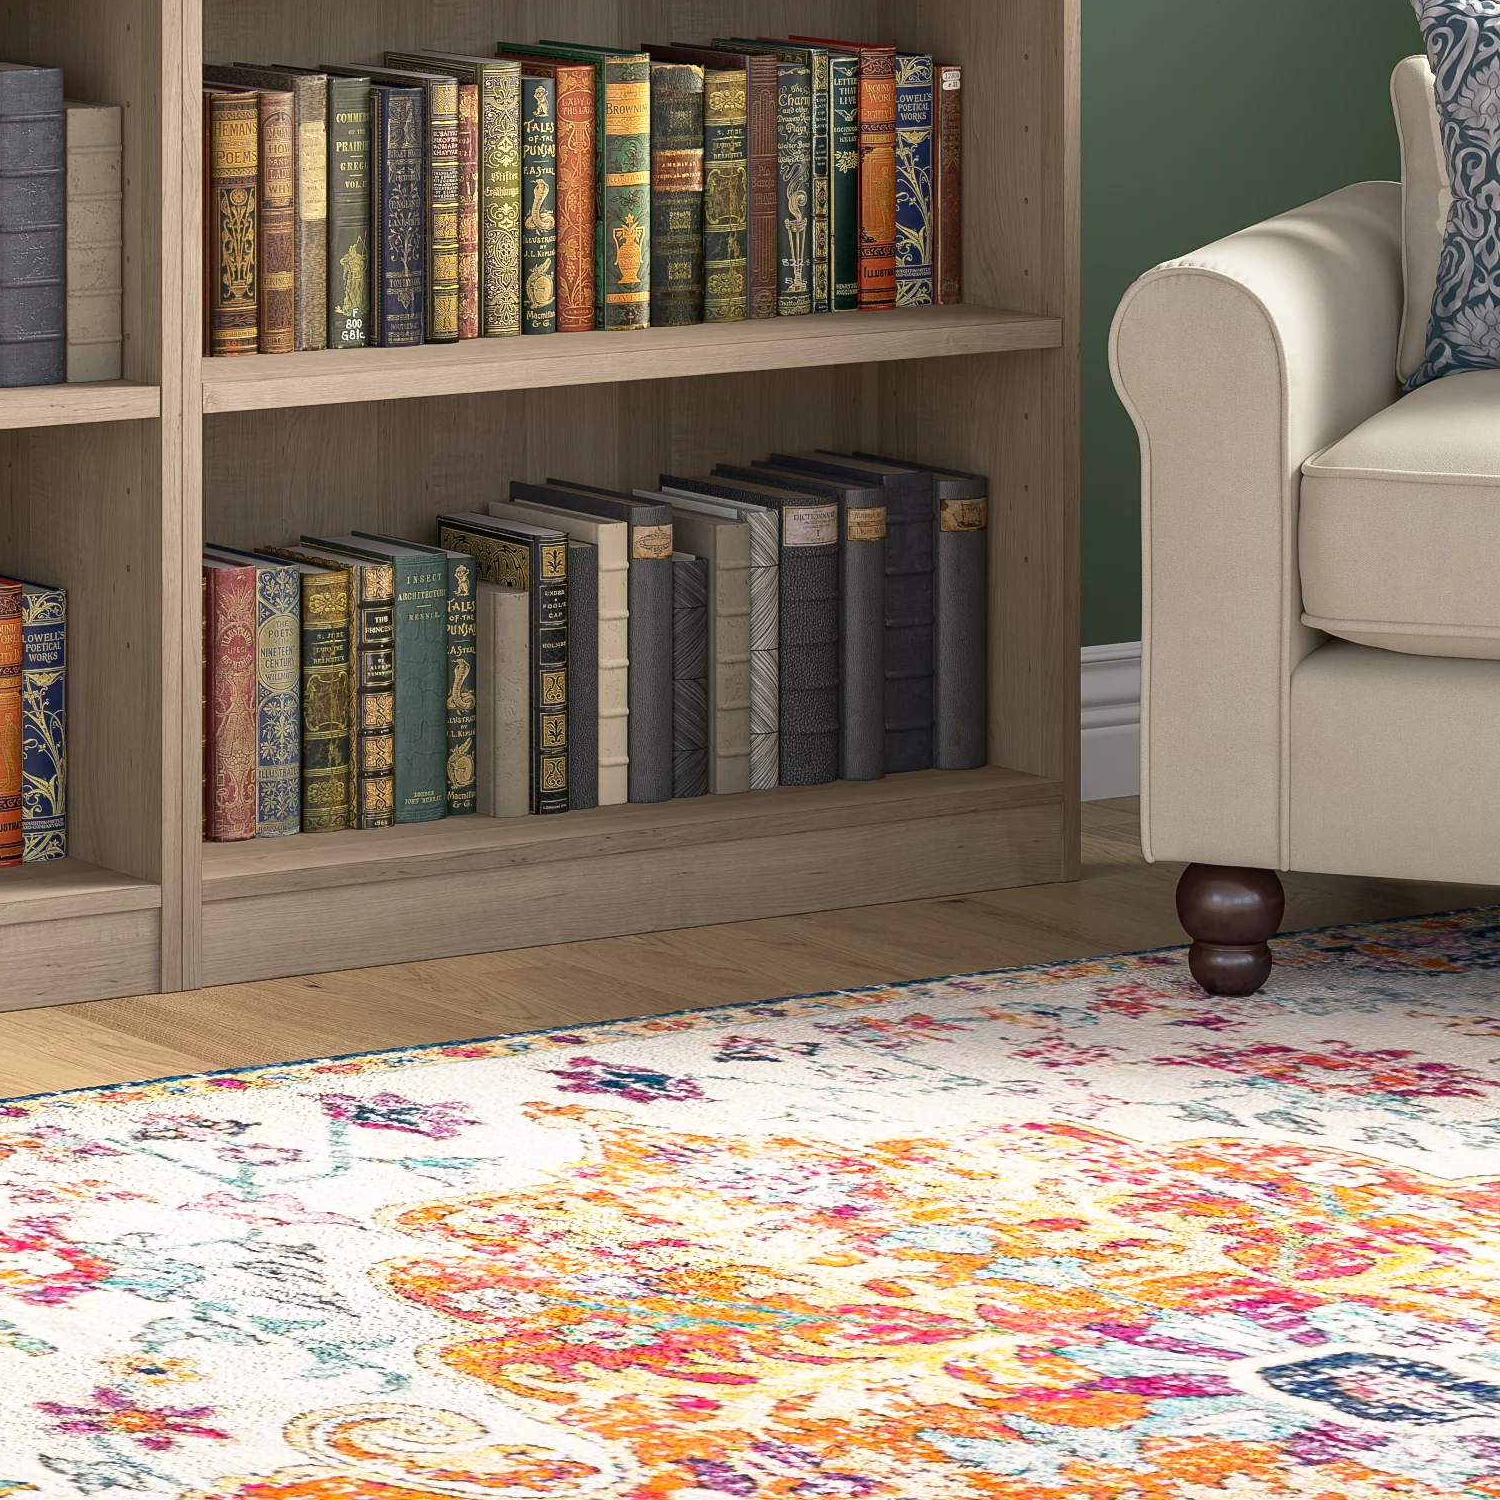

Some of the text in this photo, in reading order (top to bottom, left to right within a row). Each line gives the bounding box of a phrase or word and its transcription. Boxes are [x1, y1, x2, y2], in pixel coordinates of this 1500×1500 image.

[606, 102, 649, 115] BROWNIN
[897, 102, 930, 112] POETICAL
[900, 112, 927, 122] WORKS
[214, 121, 258, 137] HEMANS
[523, 119, 555, 133] TALES
[216, 150, 257, 166] POEMS
[268, 183, 291, 194] WHY
[352, 307, 360, 318] F
[345, 319, 363, 329] 800
[405, 572, 443, 585] INSECT
[275, 619, 290, 628] THE
[22, 630, 65, 643] LOWELL'S
[268, 629, 294, 639] POETS
[25, 641, 62, 653] POETICAL
[28, 651, 58, 663] WORKS
[264, 655, 296, 669] CENTURY
